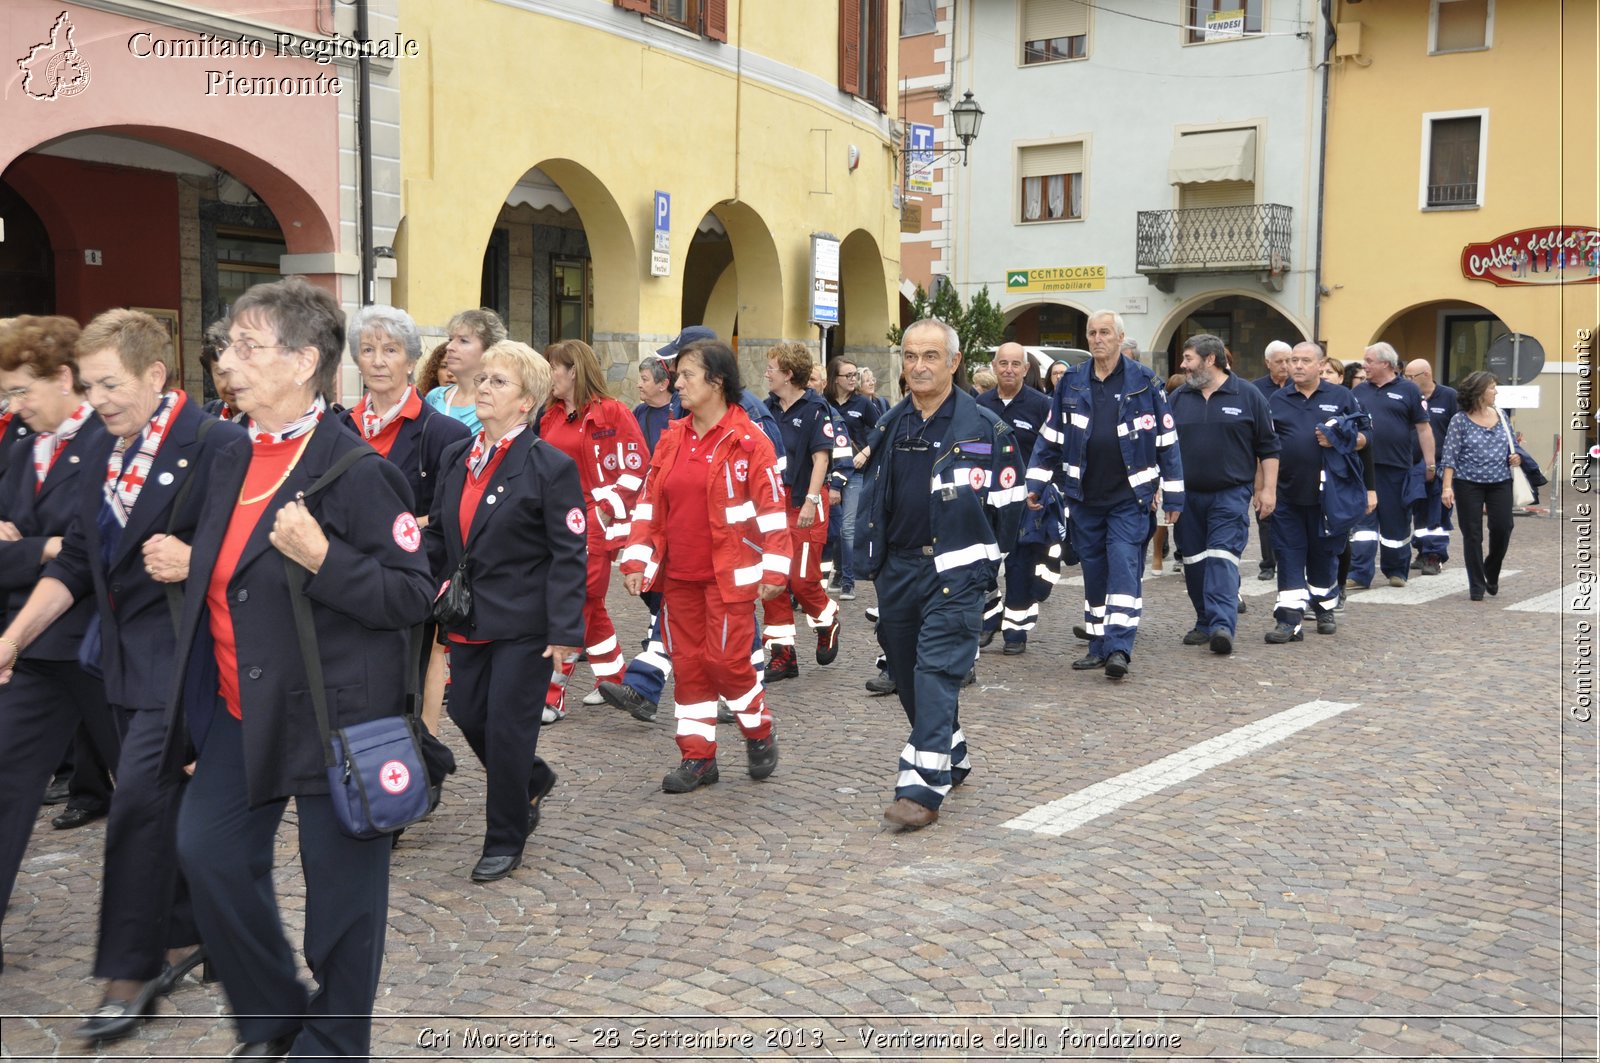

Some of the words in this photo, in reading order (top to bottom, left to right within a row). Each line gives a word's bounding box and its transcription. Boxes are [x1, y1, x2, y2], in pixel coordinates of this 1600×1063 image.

[1208, 20, 1241, 30] VENDESI
[658, 196, 668, 226] P
[1527, 230, 1577, 255] della
[1030, 266, 1104, 280] CENTROCASE
[1042, 282, 1092, 291] Immobiliare
